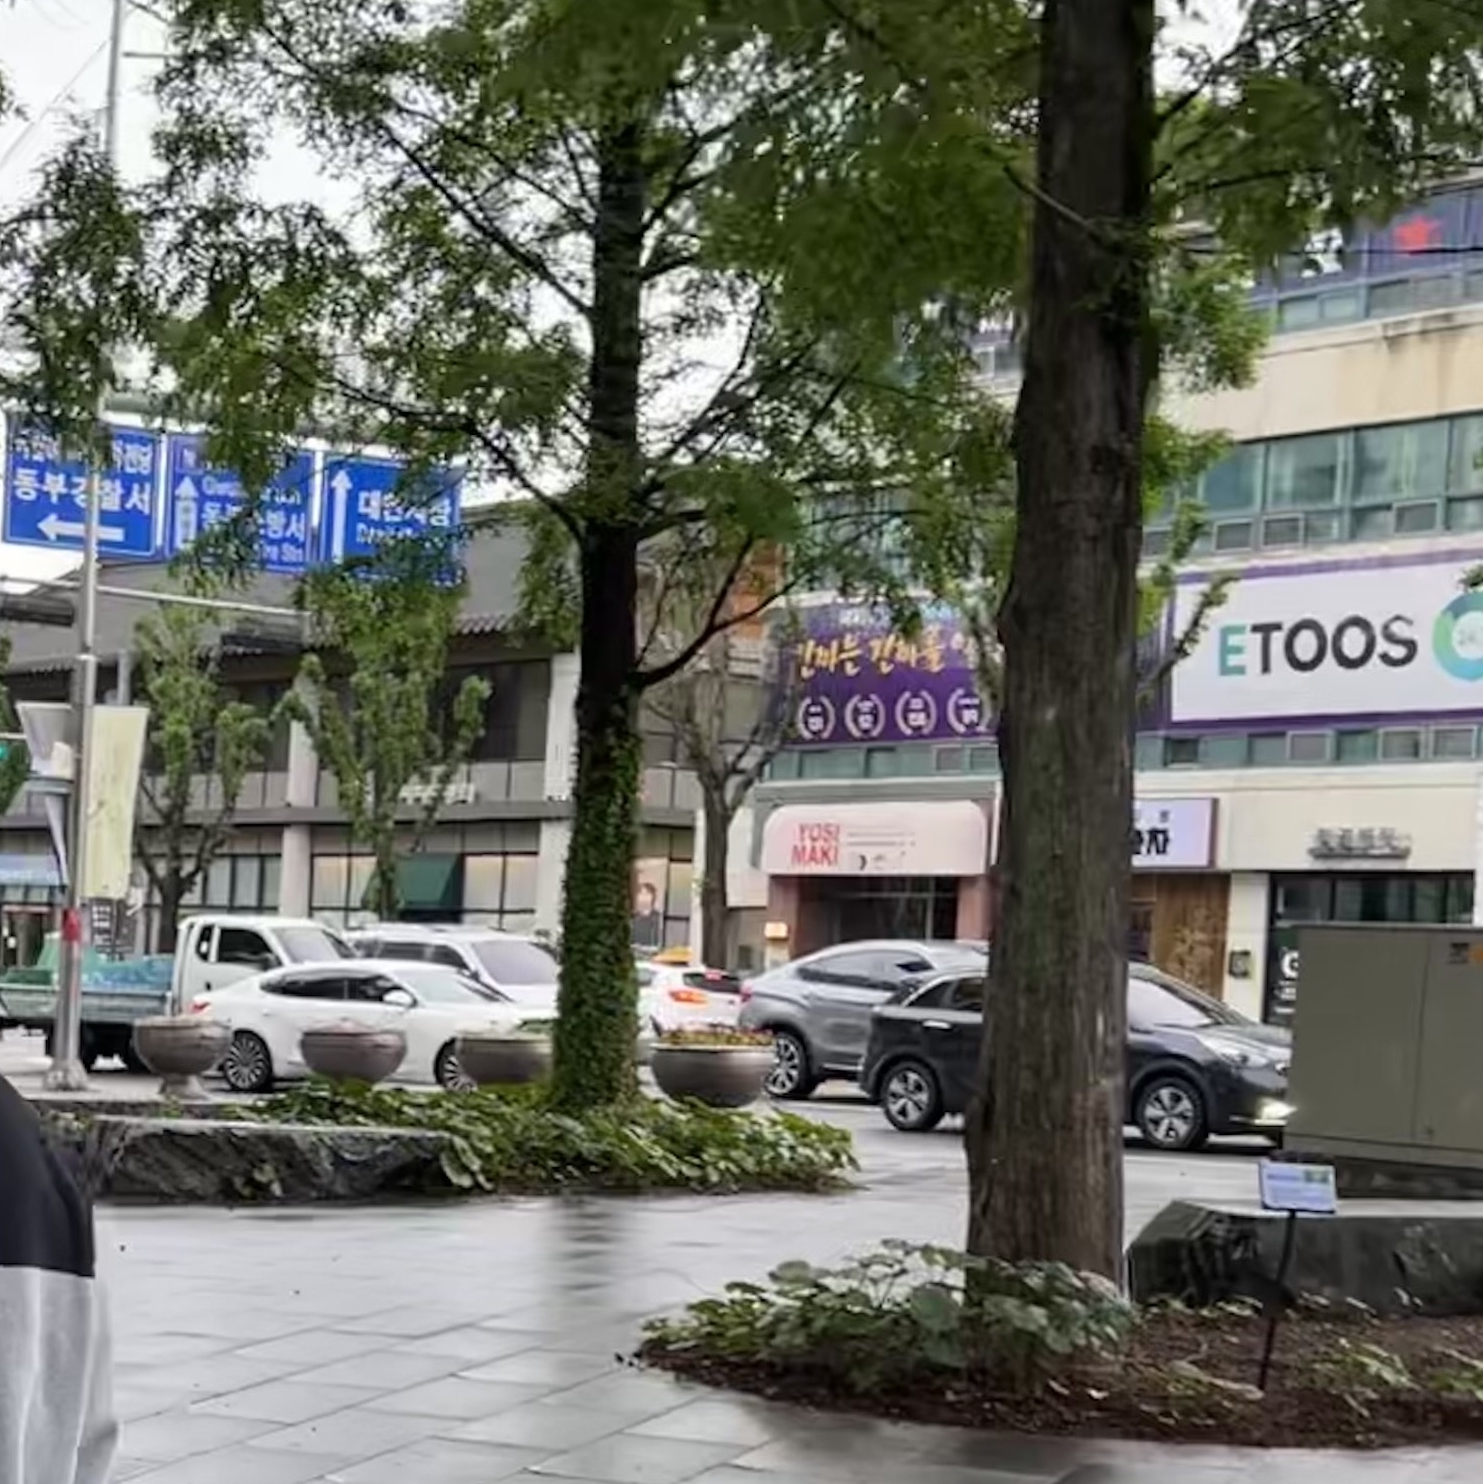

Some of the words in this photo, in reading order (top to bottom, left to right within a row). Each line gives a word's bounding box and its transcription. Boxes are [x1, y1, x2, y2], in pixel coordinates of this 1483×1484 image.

[201, 502, 305, 543] 동방서
[1219, 614, 1418, 678] ETOOS
[798, 822, 841, 844] YOSI
[790, 845, 839, 867] MAKI
